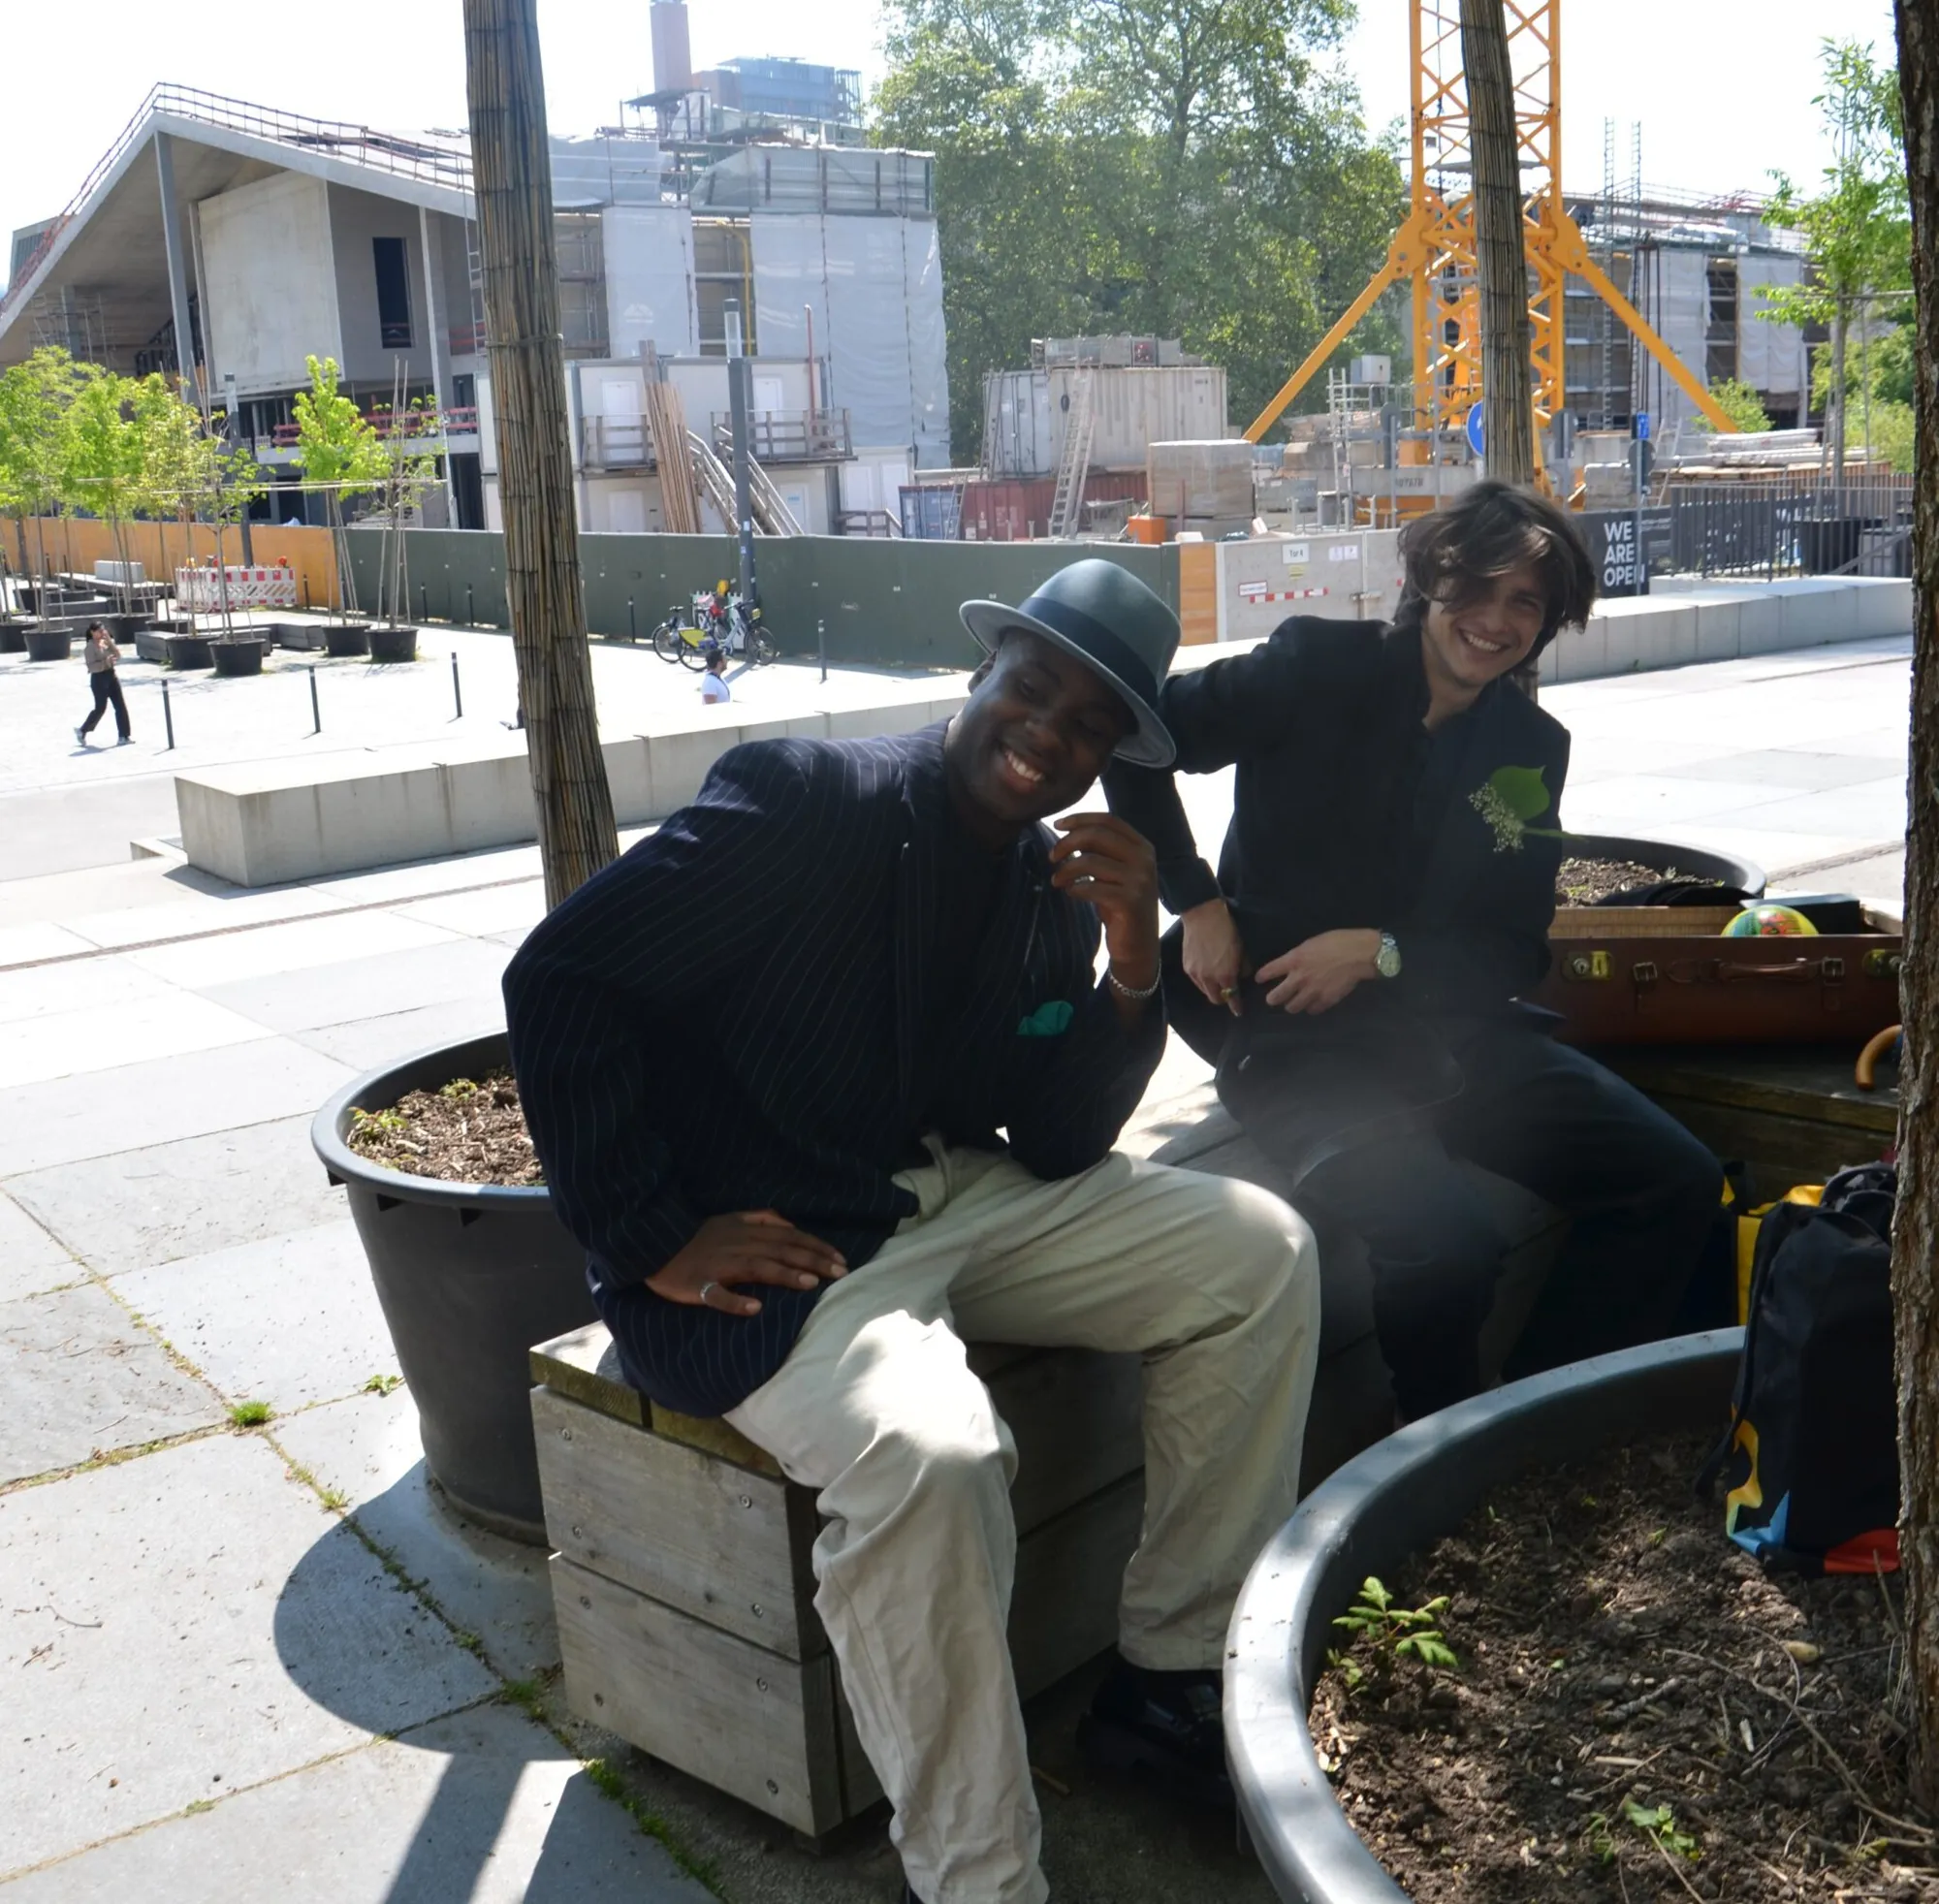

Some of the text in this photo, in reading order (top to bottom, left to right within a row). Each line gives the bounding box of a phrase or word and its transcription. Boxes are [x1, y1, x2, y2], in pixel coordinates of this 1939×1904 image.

[1604, 521, 1633, 543] WE
[1604, 543, 1636, 564] ARE
[1604, 564, 1645, 587] OPEN
